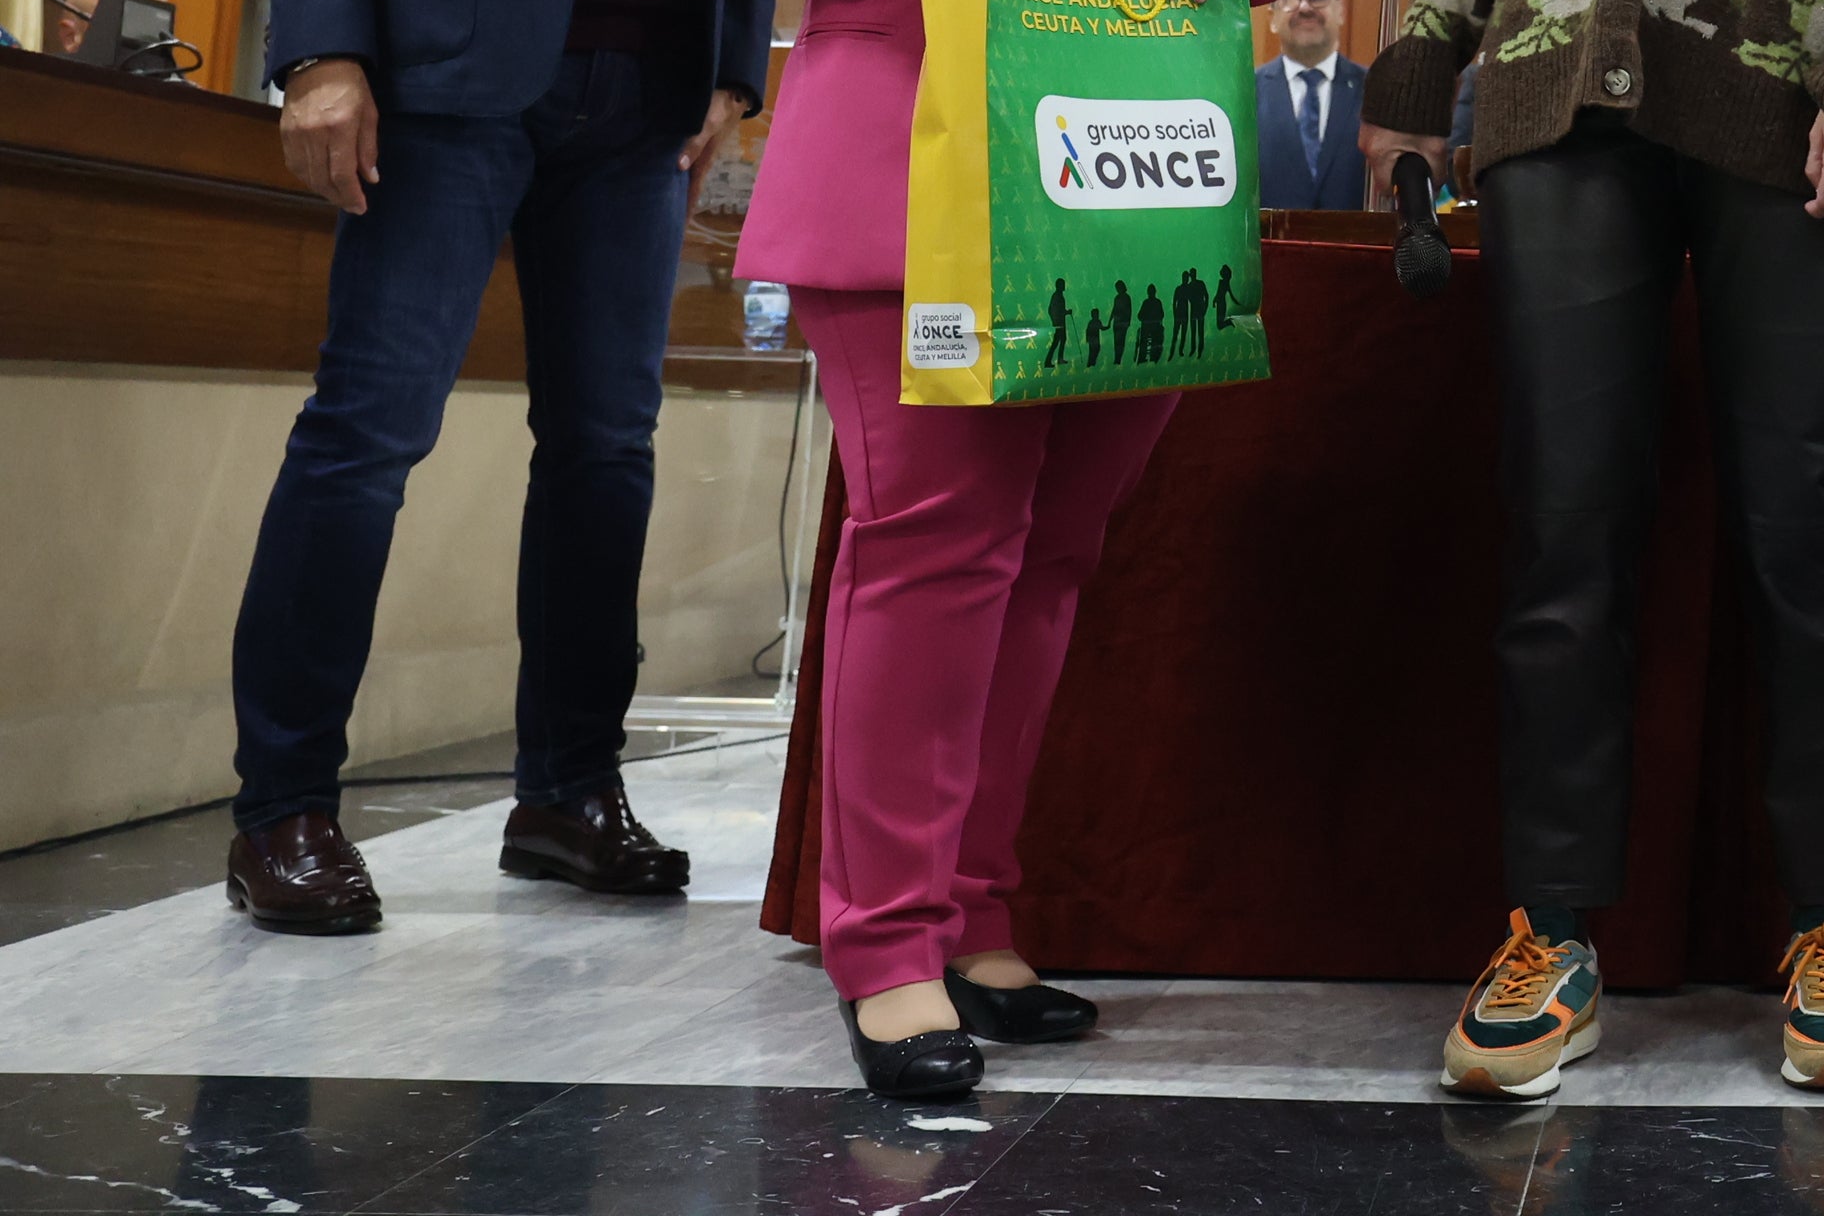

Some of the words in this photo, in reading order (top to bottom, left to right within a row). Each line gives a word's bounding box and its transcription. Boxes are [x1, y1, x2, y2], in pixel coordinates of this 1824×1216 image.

[1021, 10, 1085, 35] CEUTA
[1086, 17, 1100, 35] Y
[1105, 18, 1198, 37] MELILLA
[1087, 124, 1150, 146] grupo
[1154, 118, 1216, 140] social
[1095, 150, 1226, 189] ONCE
[921, 314, 939, 323] grupo
[940, 312, 962, 321] social
[922, 325, 963, 339] ONCE
[937, 352, 967, 360] MELILLA
